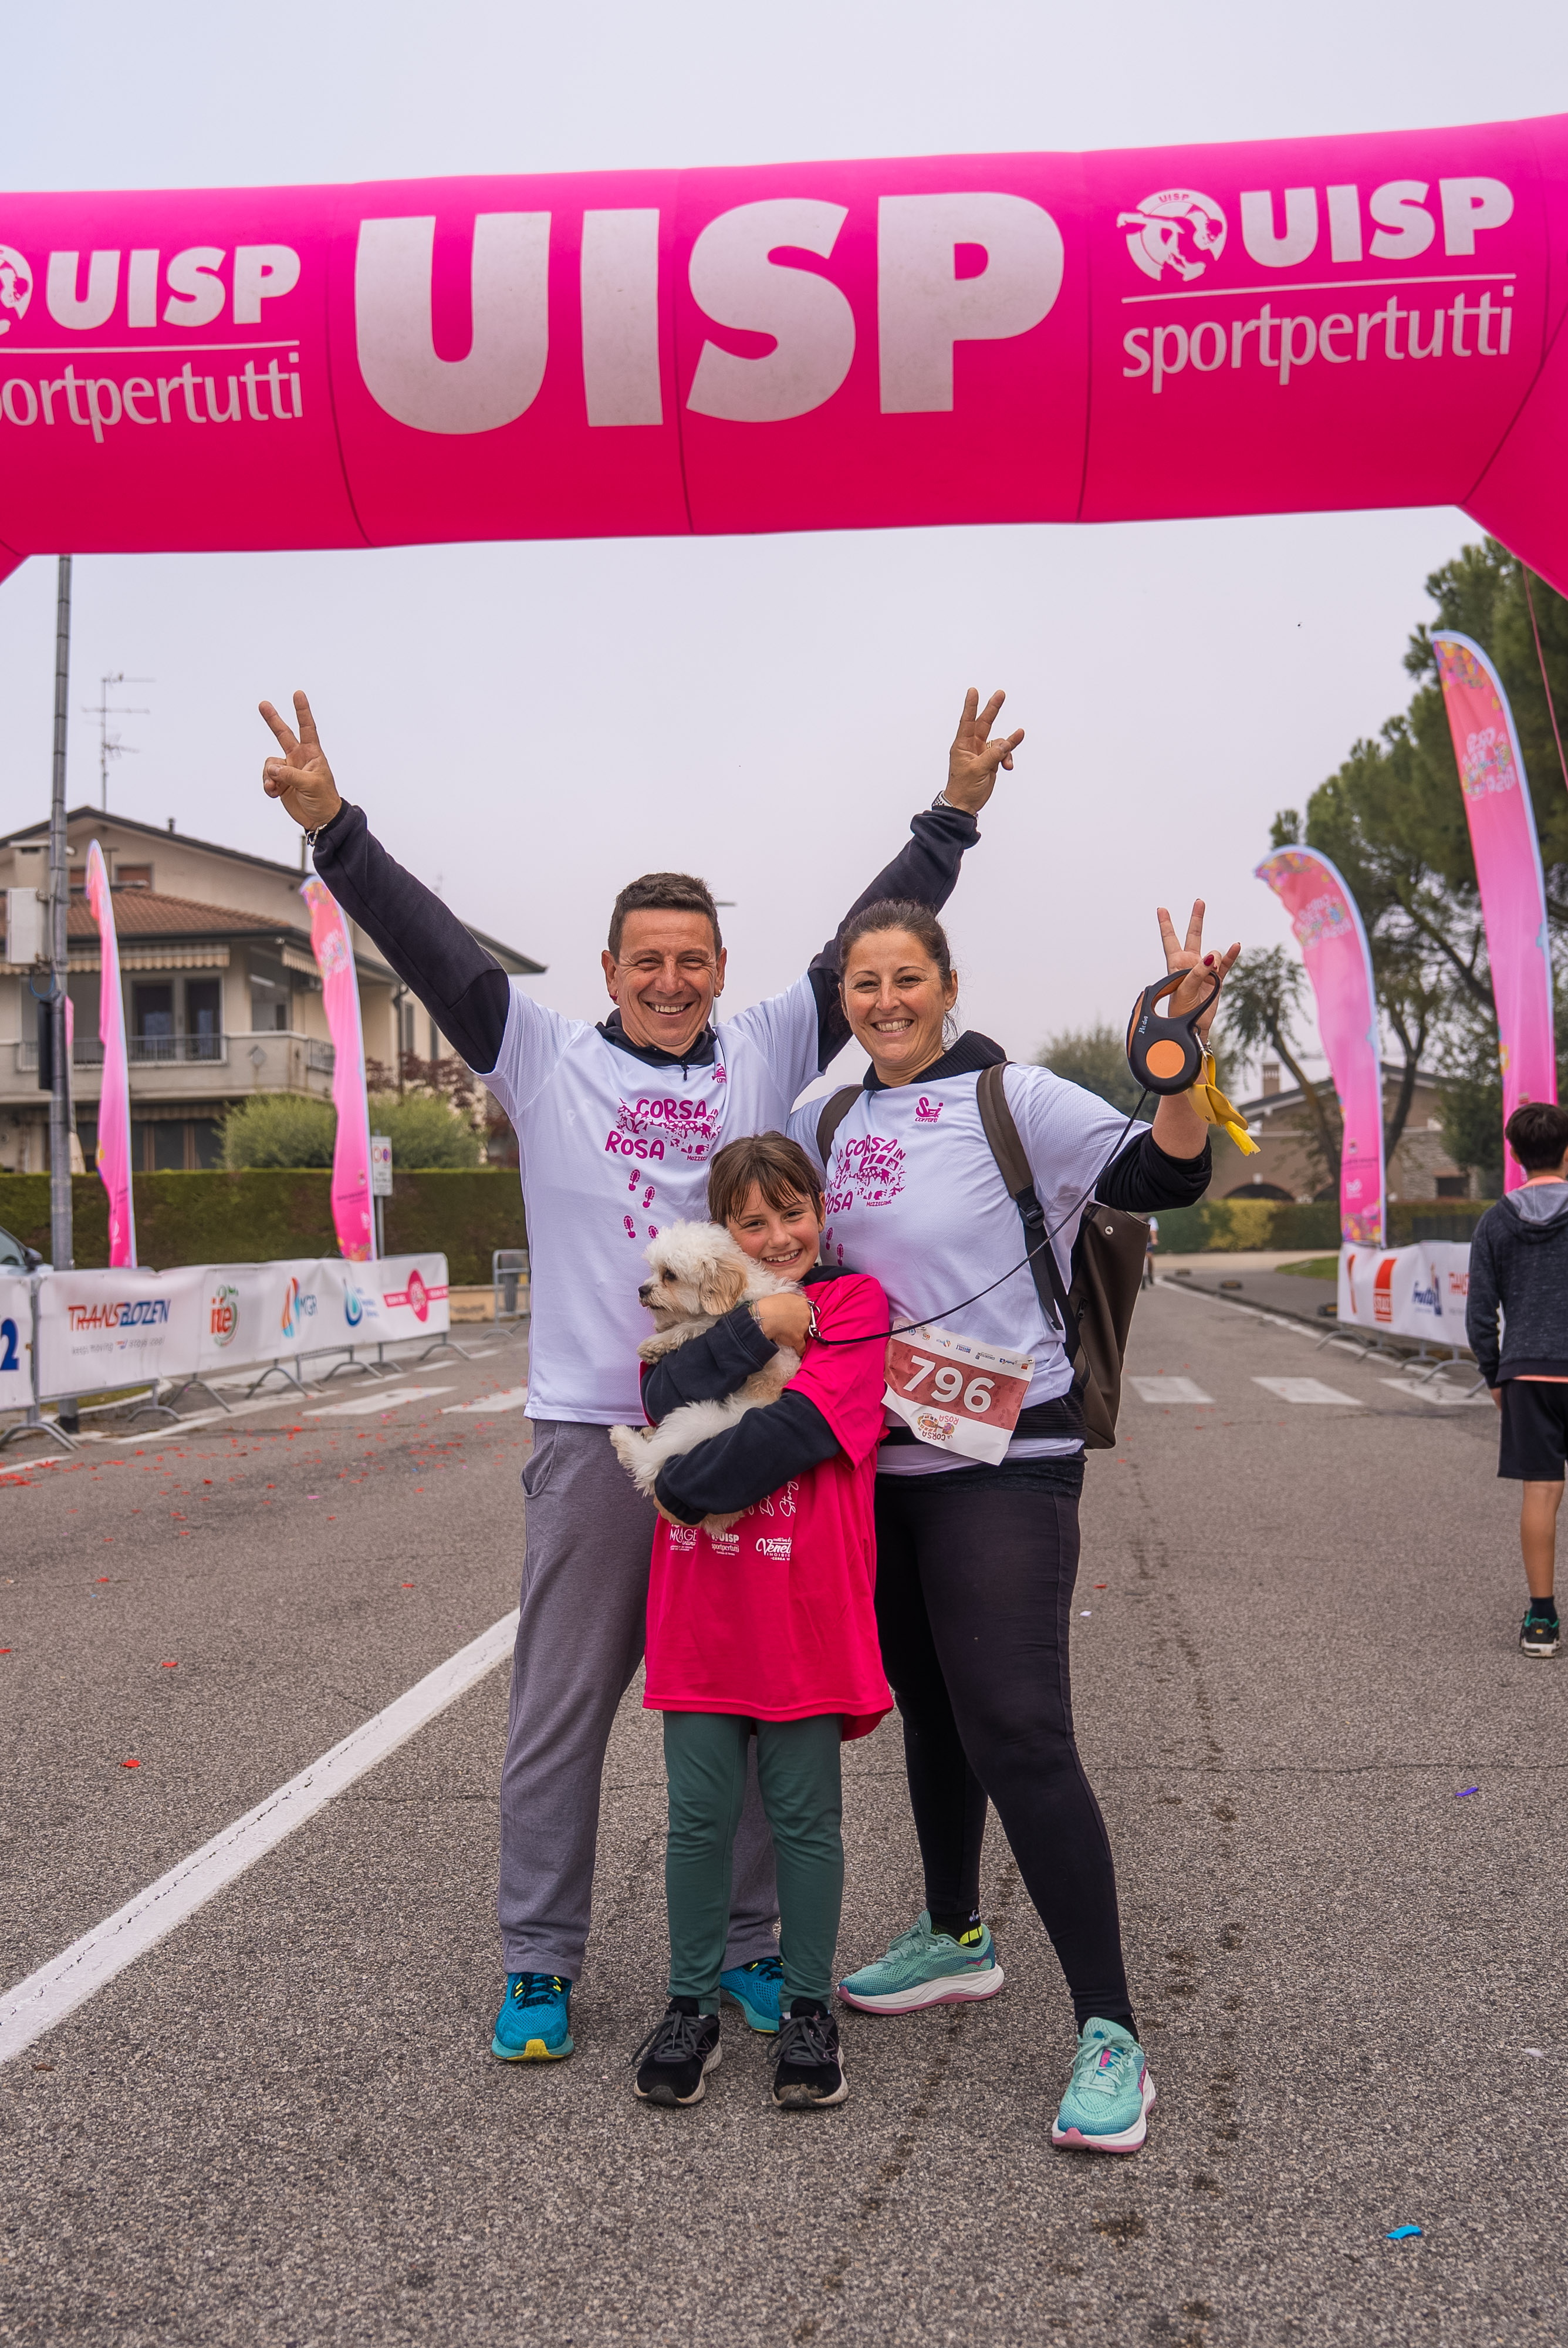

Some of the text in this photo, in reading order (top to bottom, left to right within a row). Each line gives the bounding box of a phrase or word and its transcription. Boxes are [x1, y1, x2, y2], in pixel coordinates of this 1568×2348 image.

[1159, 193, 1189, 203] UISP
[1241, 177, 1515, 268] UISP
[46, 245, 301, 330] UISP
[356, 191, 1065, 434] UISP
[1123, 286, 1515, 394] sportpertutti
[0, 353, 303, 443] ortpertutti
[636, 1098, 707, 1121] CORSA
[605, 1131, 665, 1160] ROSA
[845, 1134, 898, 1158] CORSA
[893, 1148, 906, 1160] IN
[67, 1298, 171, 1331] TRANSBOZEN
[903, 1355, 996, 1413] 796
[939, 1414, 959, 1425] ROSA
[922, 1431, 946, 1441] CORSA
[719, 1533, 739, 1543] UISP
